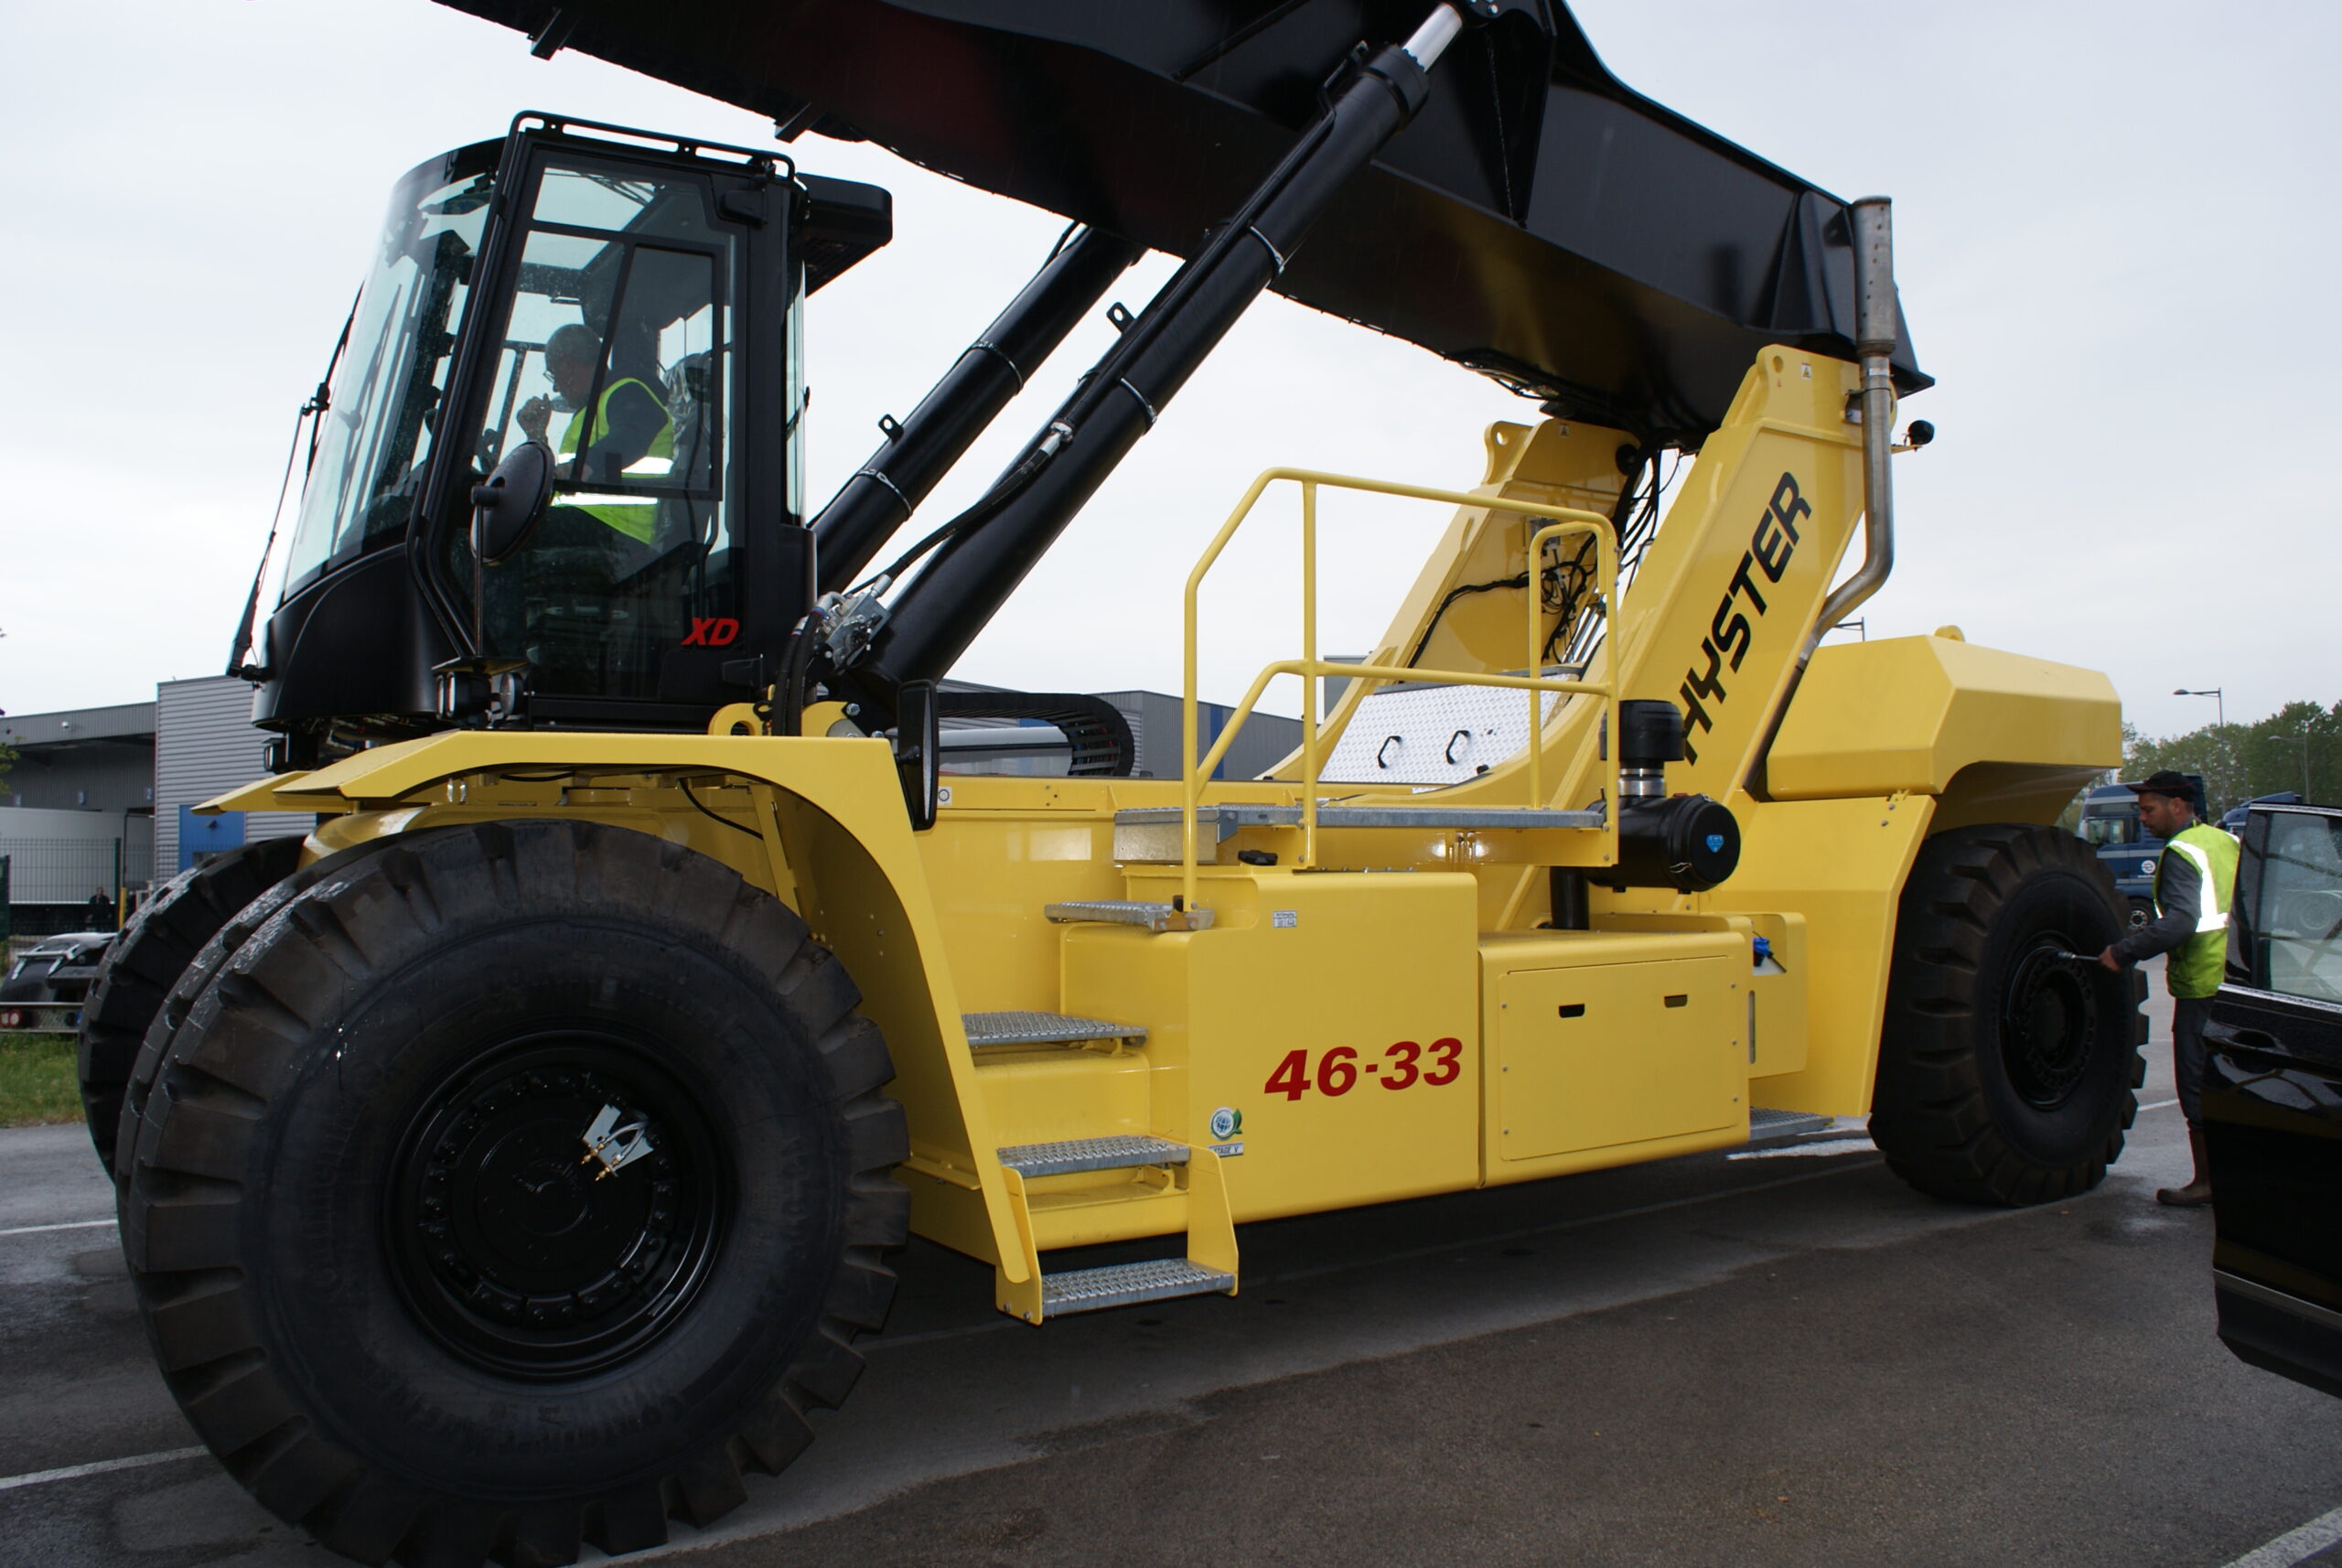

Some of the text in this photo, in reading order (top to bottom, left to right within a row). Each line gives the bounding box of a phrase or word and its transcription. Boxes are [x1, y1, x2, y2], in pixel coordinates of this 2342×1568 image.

[680, 617, 740, 646] XD
[1680, 471, 1812, 768] HYSTER
[1263, 1037, 1463, 1101] 46-33
